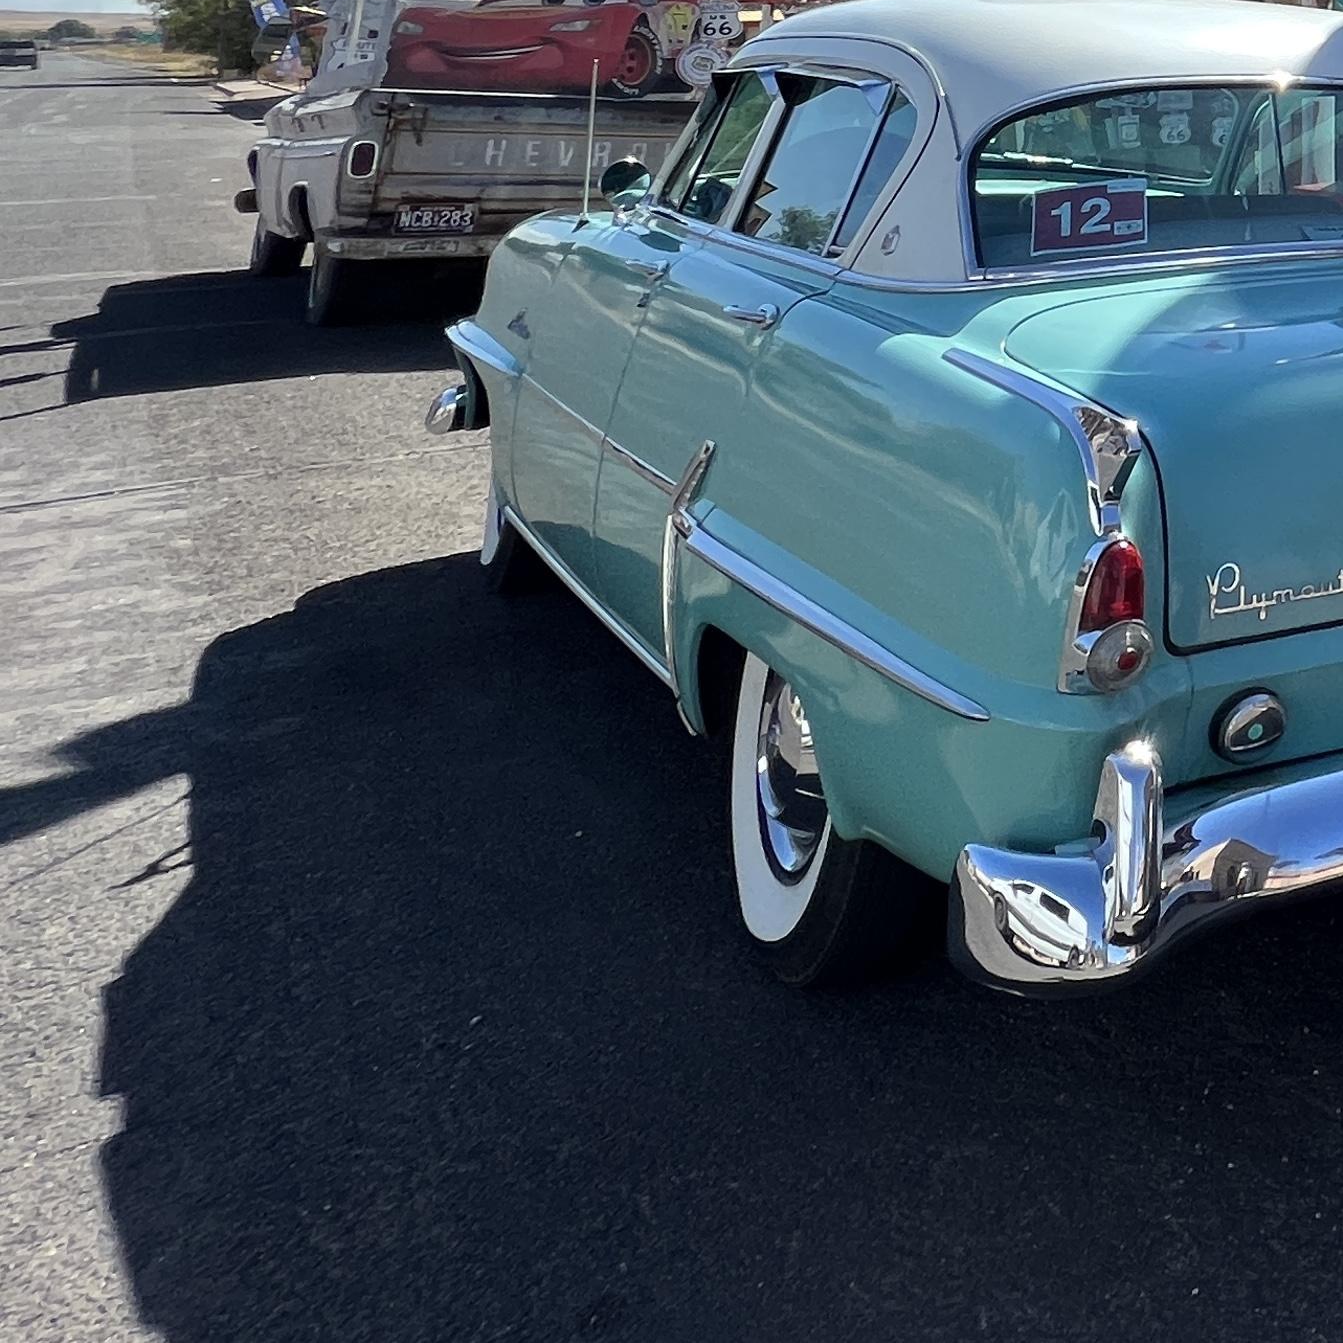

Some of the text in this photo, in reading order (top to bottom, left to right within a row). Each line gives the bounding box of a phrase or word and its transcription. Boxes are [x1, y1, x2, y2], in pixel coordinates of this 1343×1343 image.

[703, 20, 733, 36] 66
[1166, 129, 1186, 141] 66
[1050, 197, 1111, 236] 12
